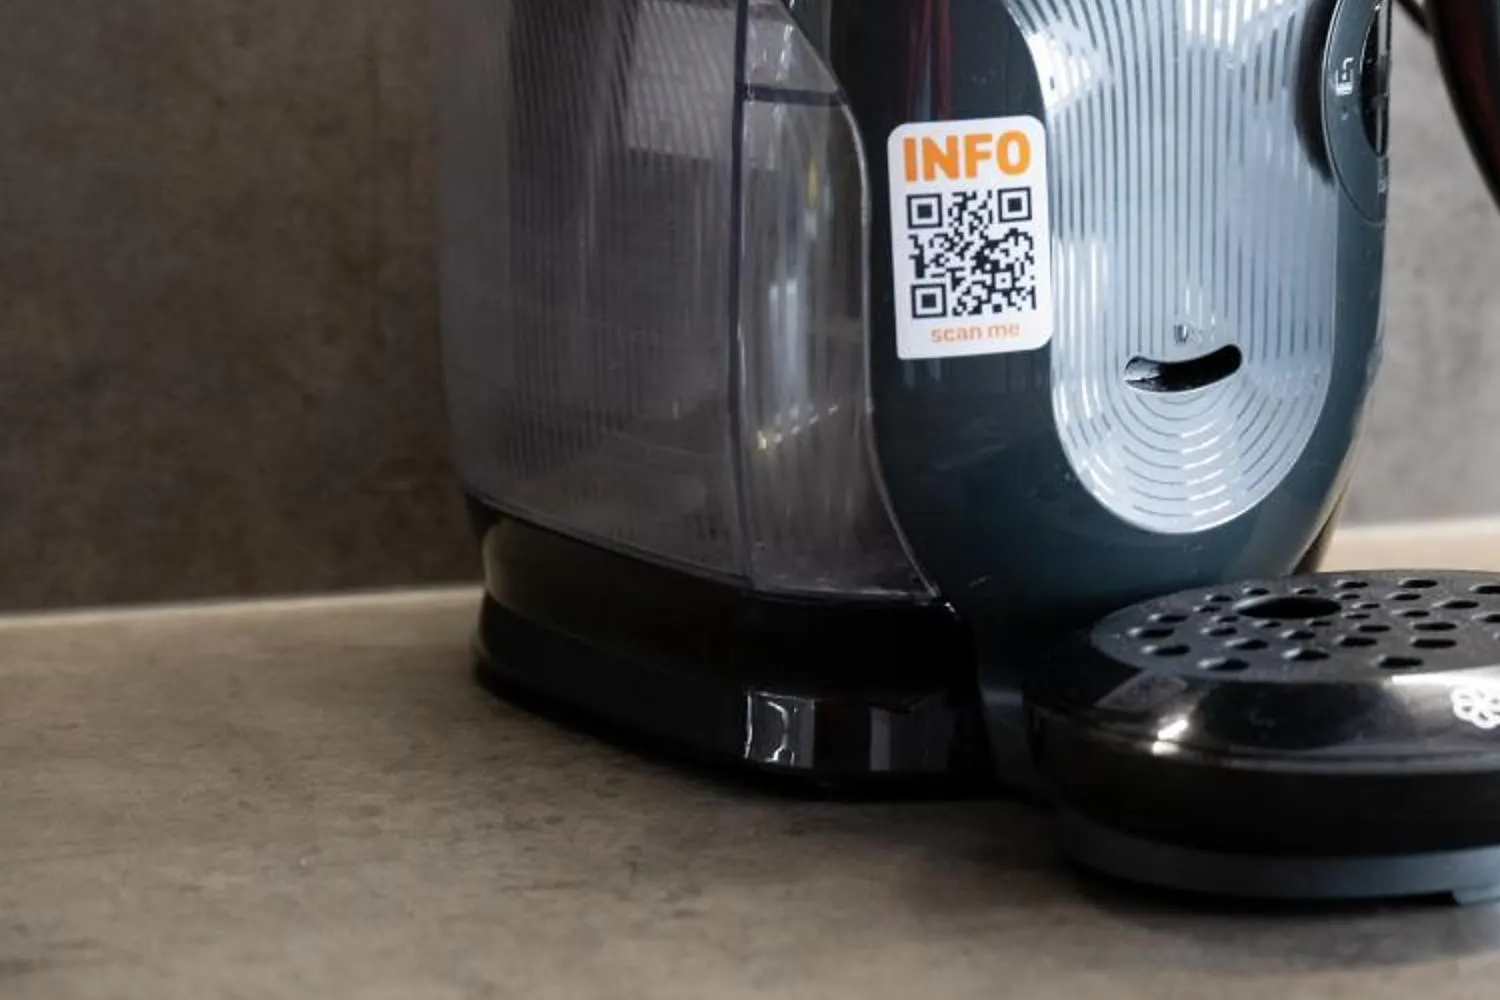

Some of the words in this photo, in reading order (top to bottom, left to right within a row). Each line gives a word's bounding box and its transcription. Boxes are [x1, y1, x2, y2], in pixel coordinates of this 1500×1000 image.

[903, 130, 1031, 182] INFO
[931, 326, 982, 343] scan
[987, 323, 1020, 338] me
